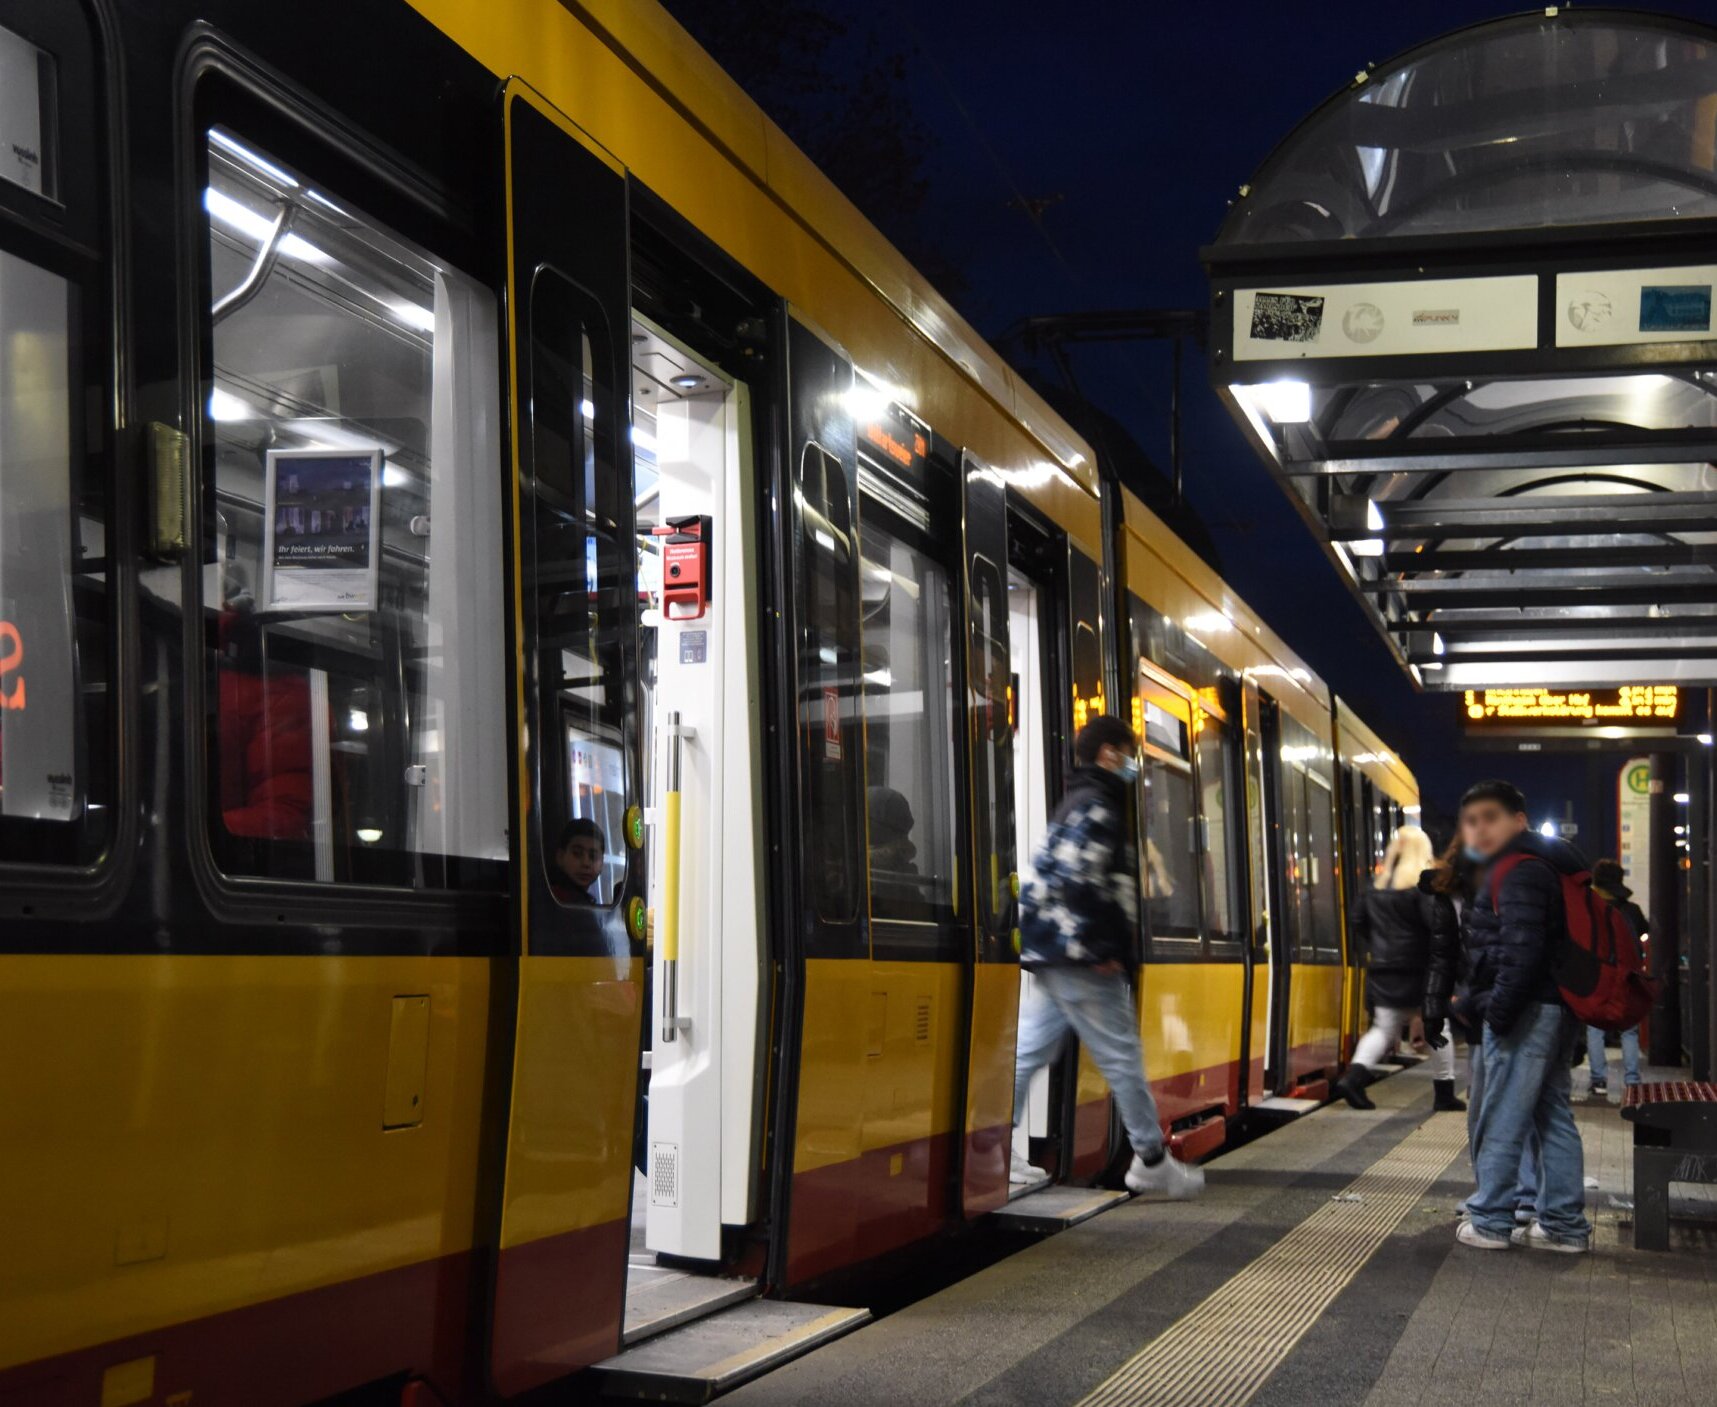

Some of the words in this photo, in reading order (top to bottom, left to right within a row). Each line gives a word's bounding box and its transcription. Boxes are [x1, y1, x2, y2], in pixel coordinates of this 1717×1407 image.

[278, 544, 289, 553] Ihr
[290, 544, 313, 555] feiert,
[314, 544, 327, 553] wir
